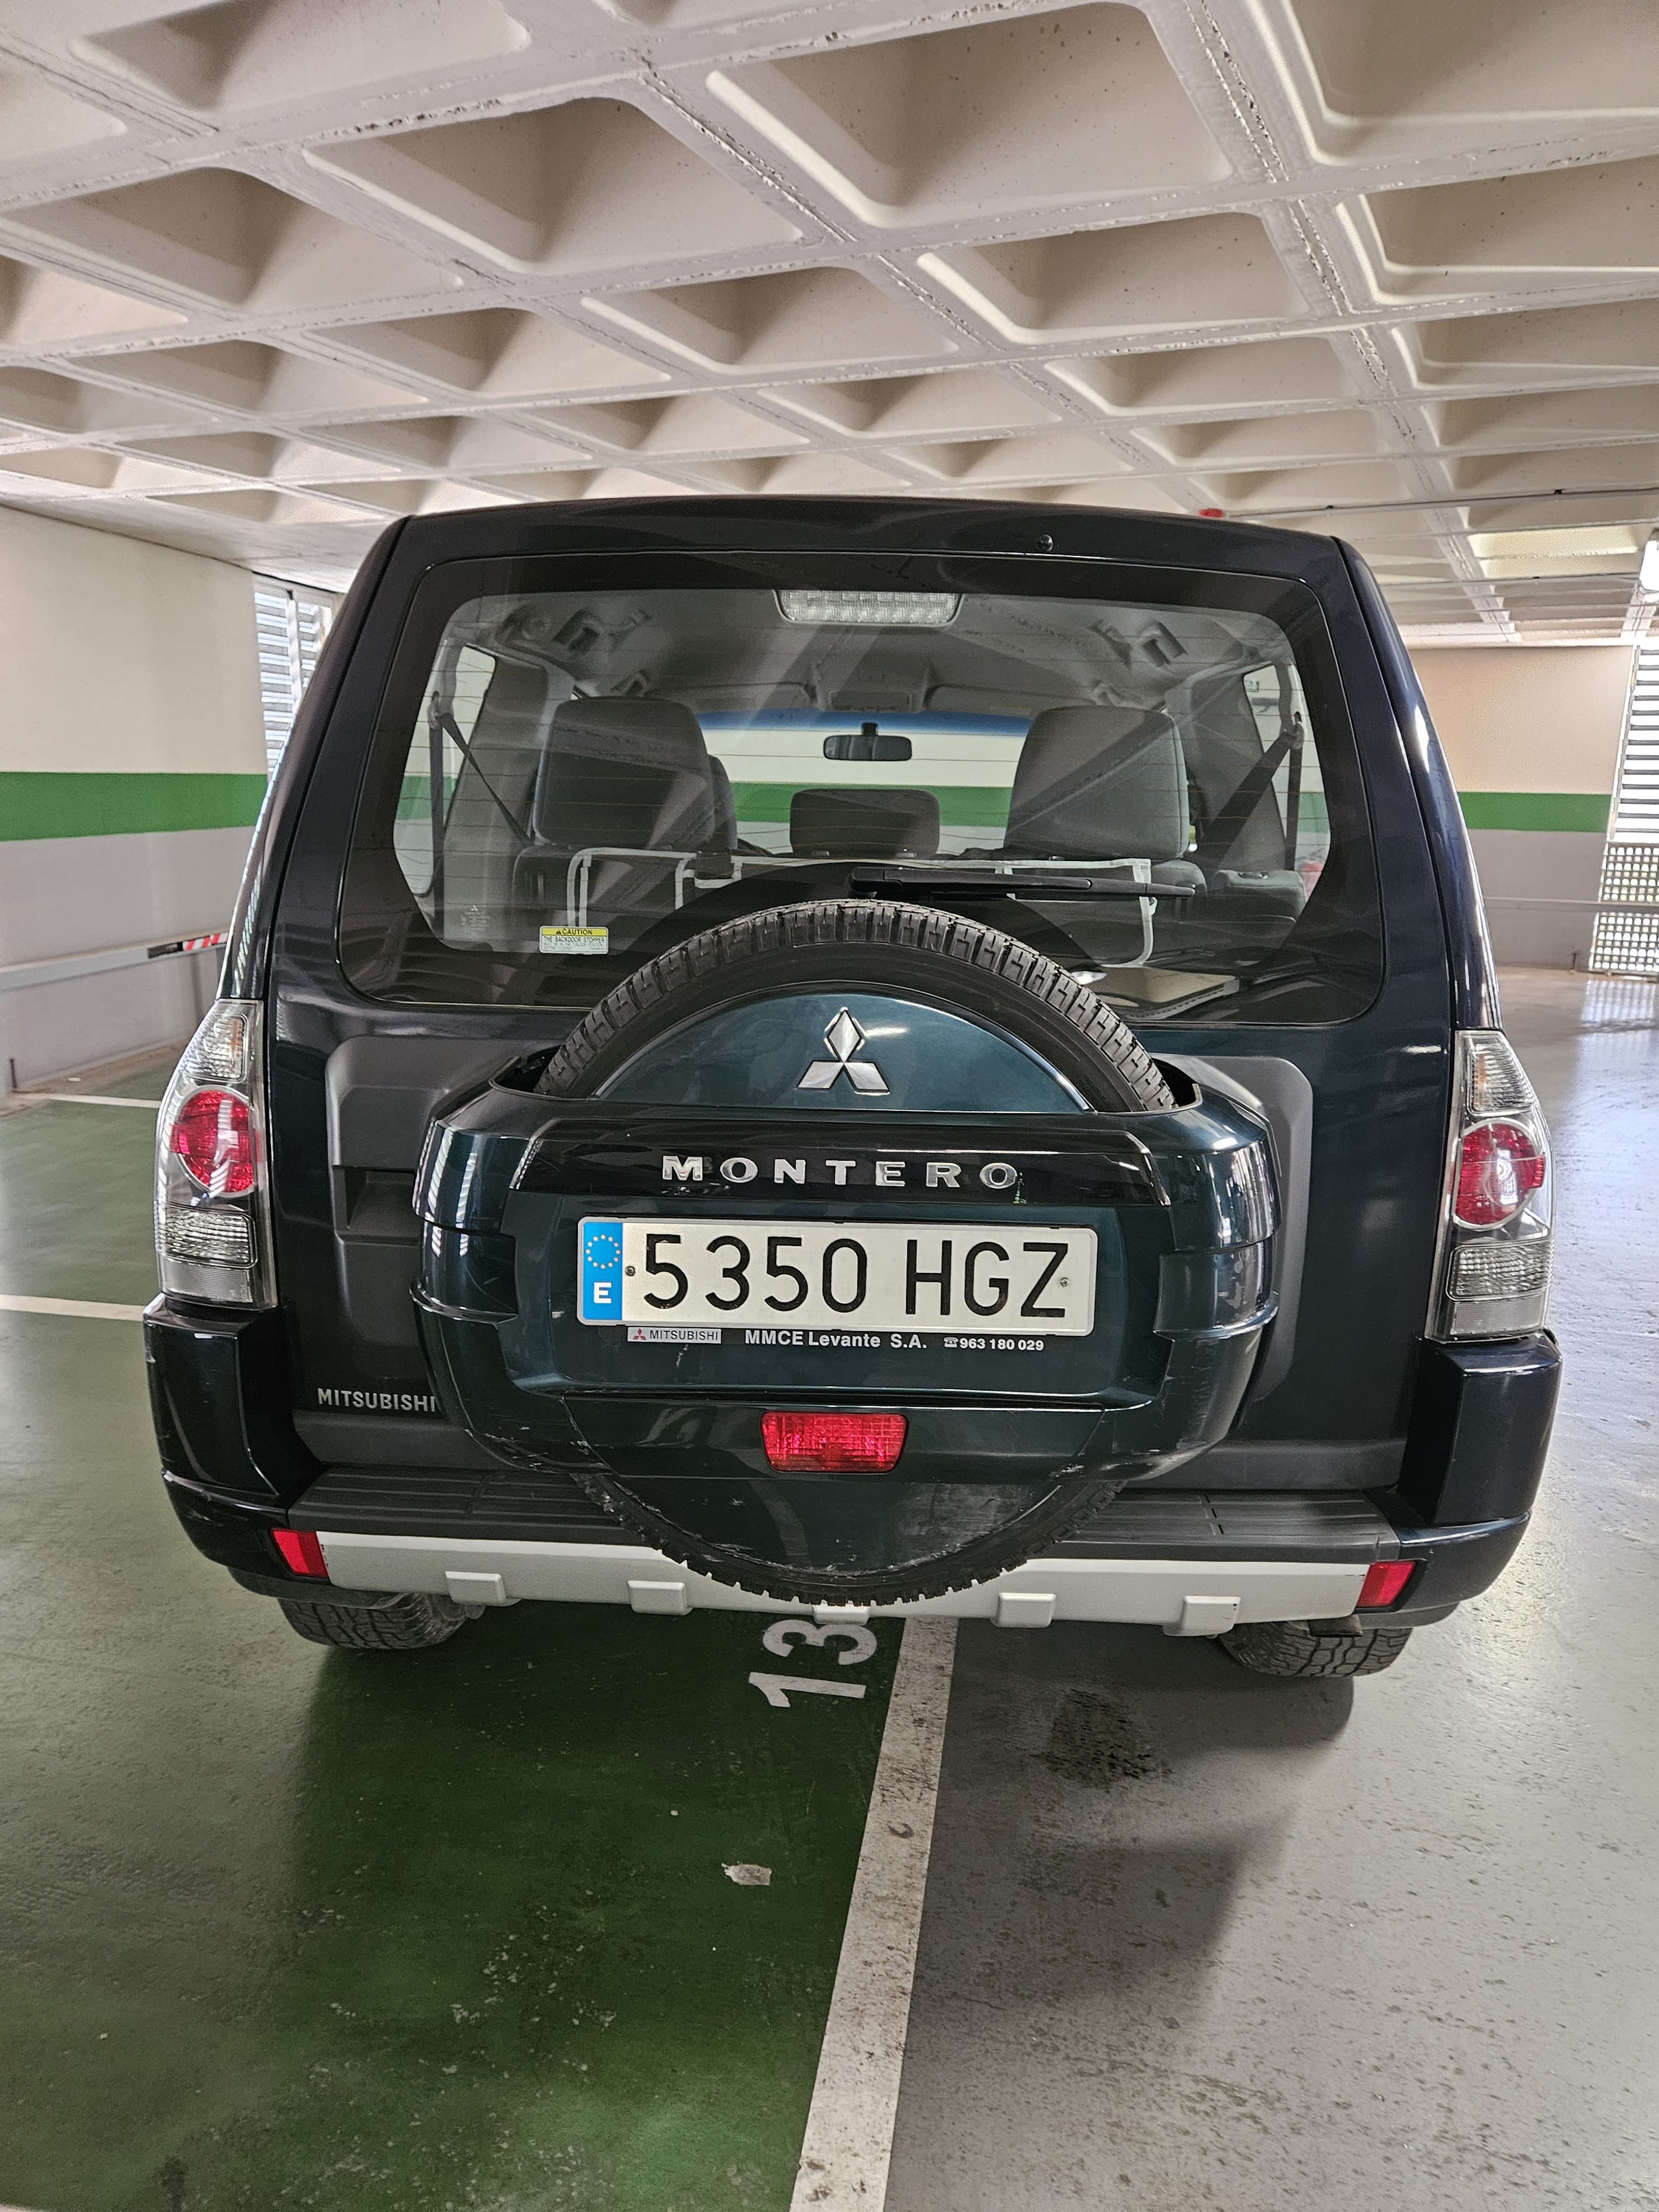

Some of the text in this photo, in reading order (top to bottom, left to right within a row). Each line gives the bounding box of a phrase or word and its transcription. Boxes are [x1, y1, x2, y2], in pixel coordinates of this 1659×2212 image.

[662, 1155, 1018, 1189] MONTERO
[644, 1233, 1068, 1318] 5350 HGZ
[593, 1282, 612, 1304] E
[650, 1330, 718, 1341] MITSUBISHI
[745, 1330, 1045, 1351] MMCE Levante S.A. 963 180 029
[317, 1387, 435, 1412] MITSUBISHI
[748, 1619, 877, 1708] 13
